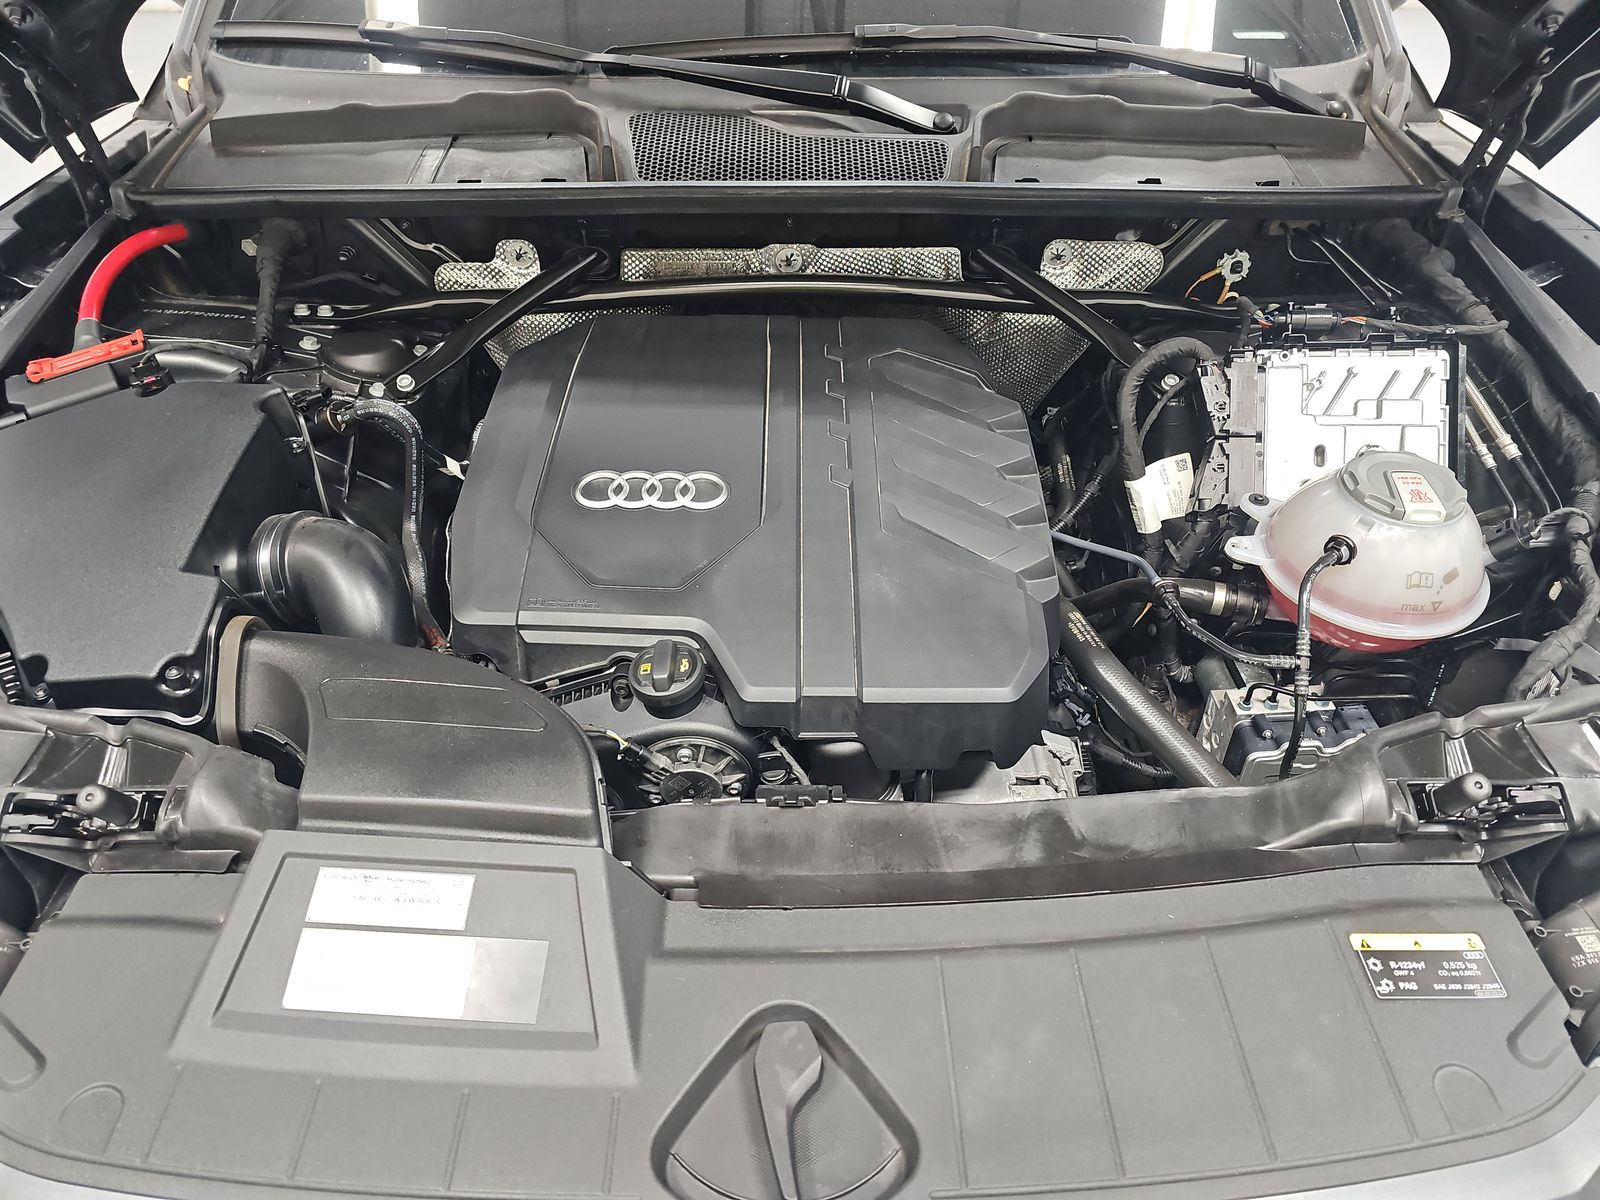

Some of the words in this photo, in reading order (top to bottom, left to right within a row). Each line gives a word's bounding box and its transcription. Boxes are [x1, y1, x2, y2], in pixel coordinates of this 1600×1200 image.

[1401, 603, 1425, 611] max
[1466, 961, 1478, 970] kg
[1398, 981, 1419, 990] PAG
